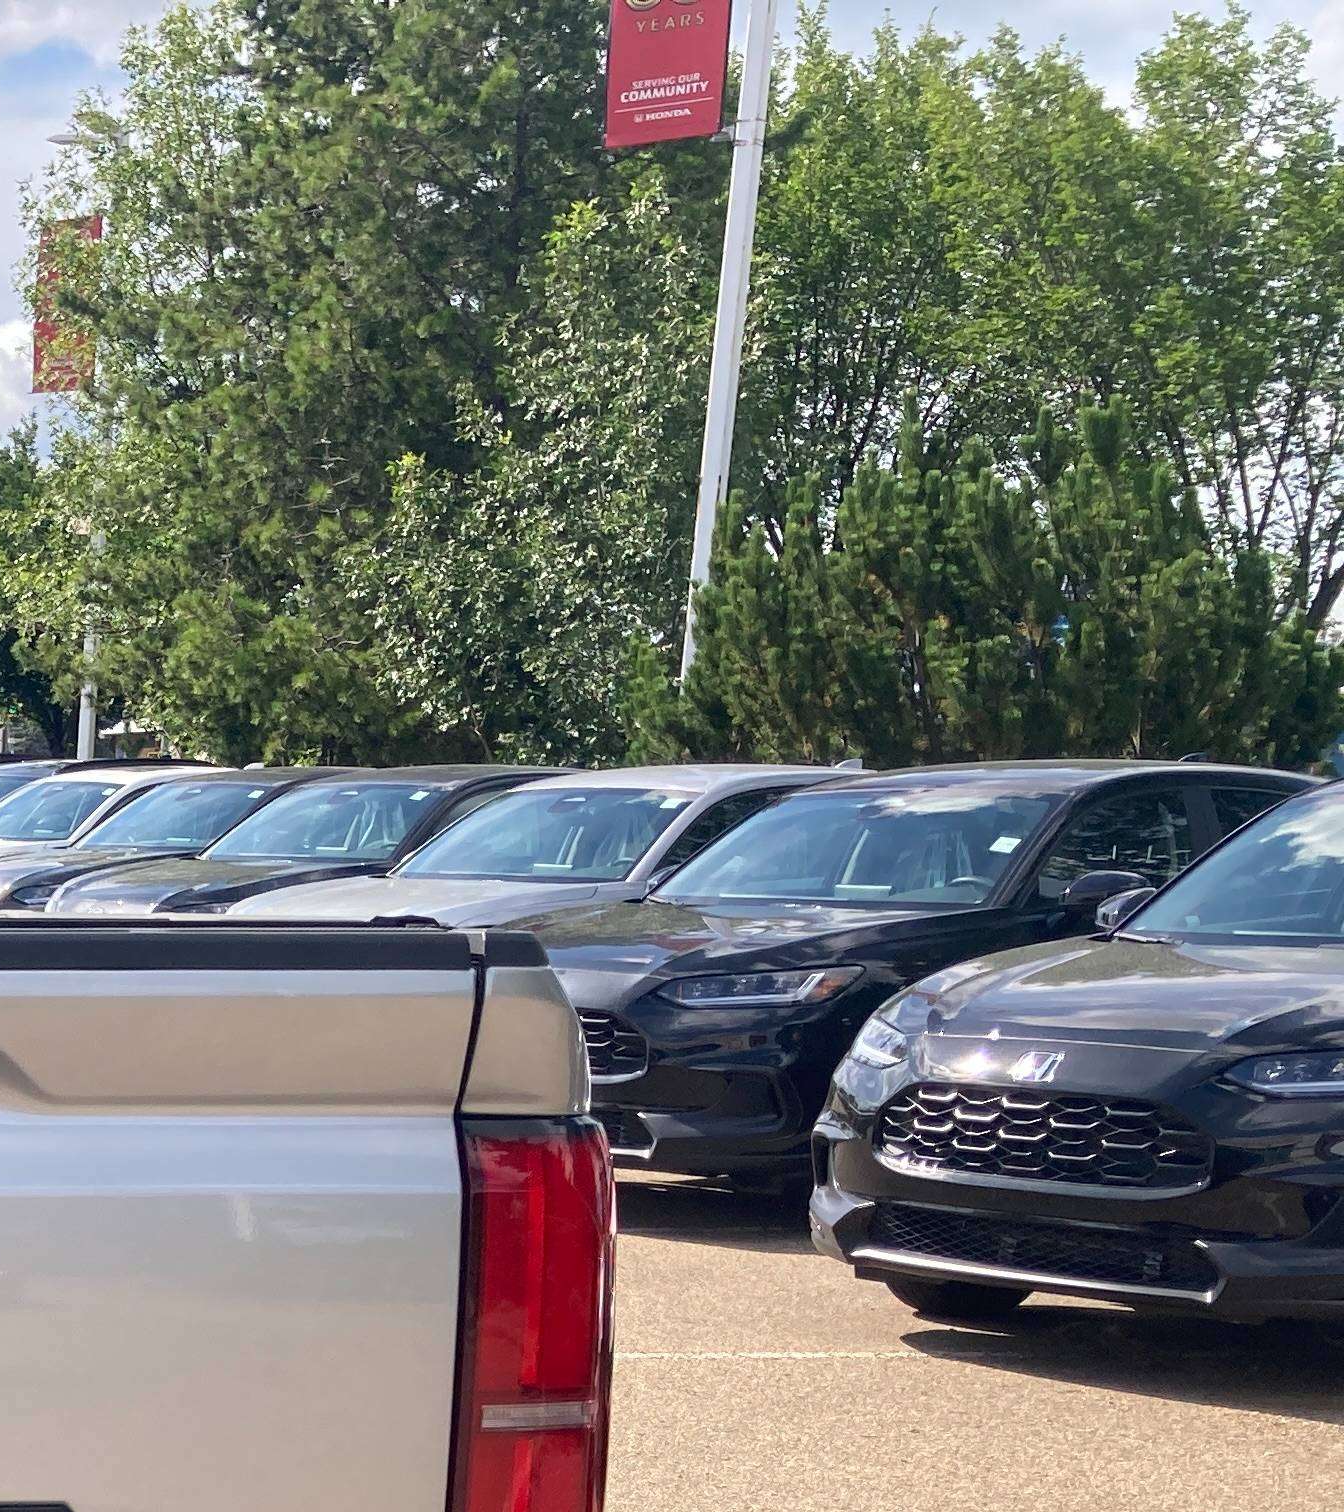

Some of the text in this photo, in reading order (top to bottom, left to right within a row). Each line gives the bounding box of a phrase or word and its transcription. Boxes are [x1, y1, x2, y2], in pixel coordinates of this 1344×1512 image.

[635, 11, 705, 33] YEARS
[631, 72, 701, 90] SERVING OUR
[620, 81, 710, 104] COMMUNITY
[645, 108, 692, 121] HONDA
